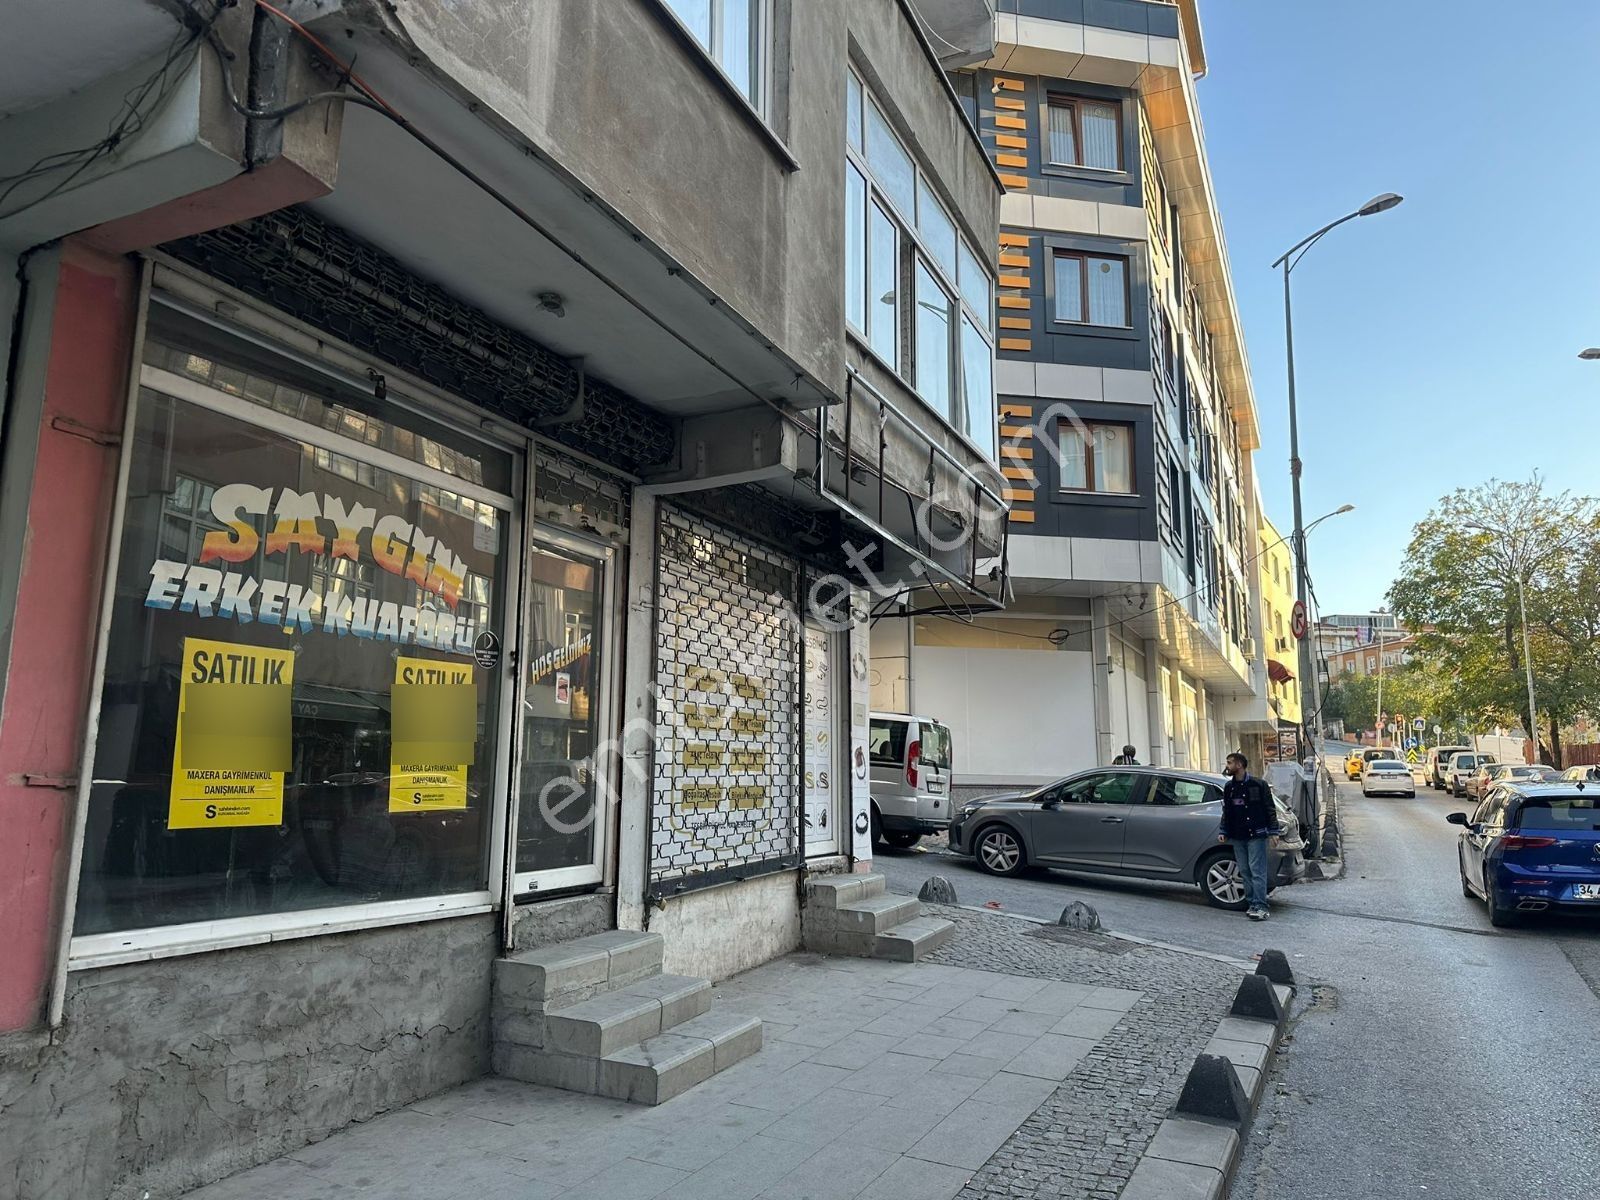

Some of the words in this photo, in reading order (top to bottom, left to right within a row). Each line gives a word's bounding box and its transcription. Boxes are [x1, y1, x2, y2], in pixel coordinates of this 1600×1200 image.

[199, 484, 468, 609] SAYGIN
[145, 559, 321, 635] ERKEK
[191, 650, 286, 684] SATILIK
[400, 764, 423, 772] MAXERA
[187, 771, 220, 780] MAXERA
[204, 785, 256, 796] DANIŞMANLIK
[205, 804, 217, 818] S
[1579, 884, 1593, 895] 34
